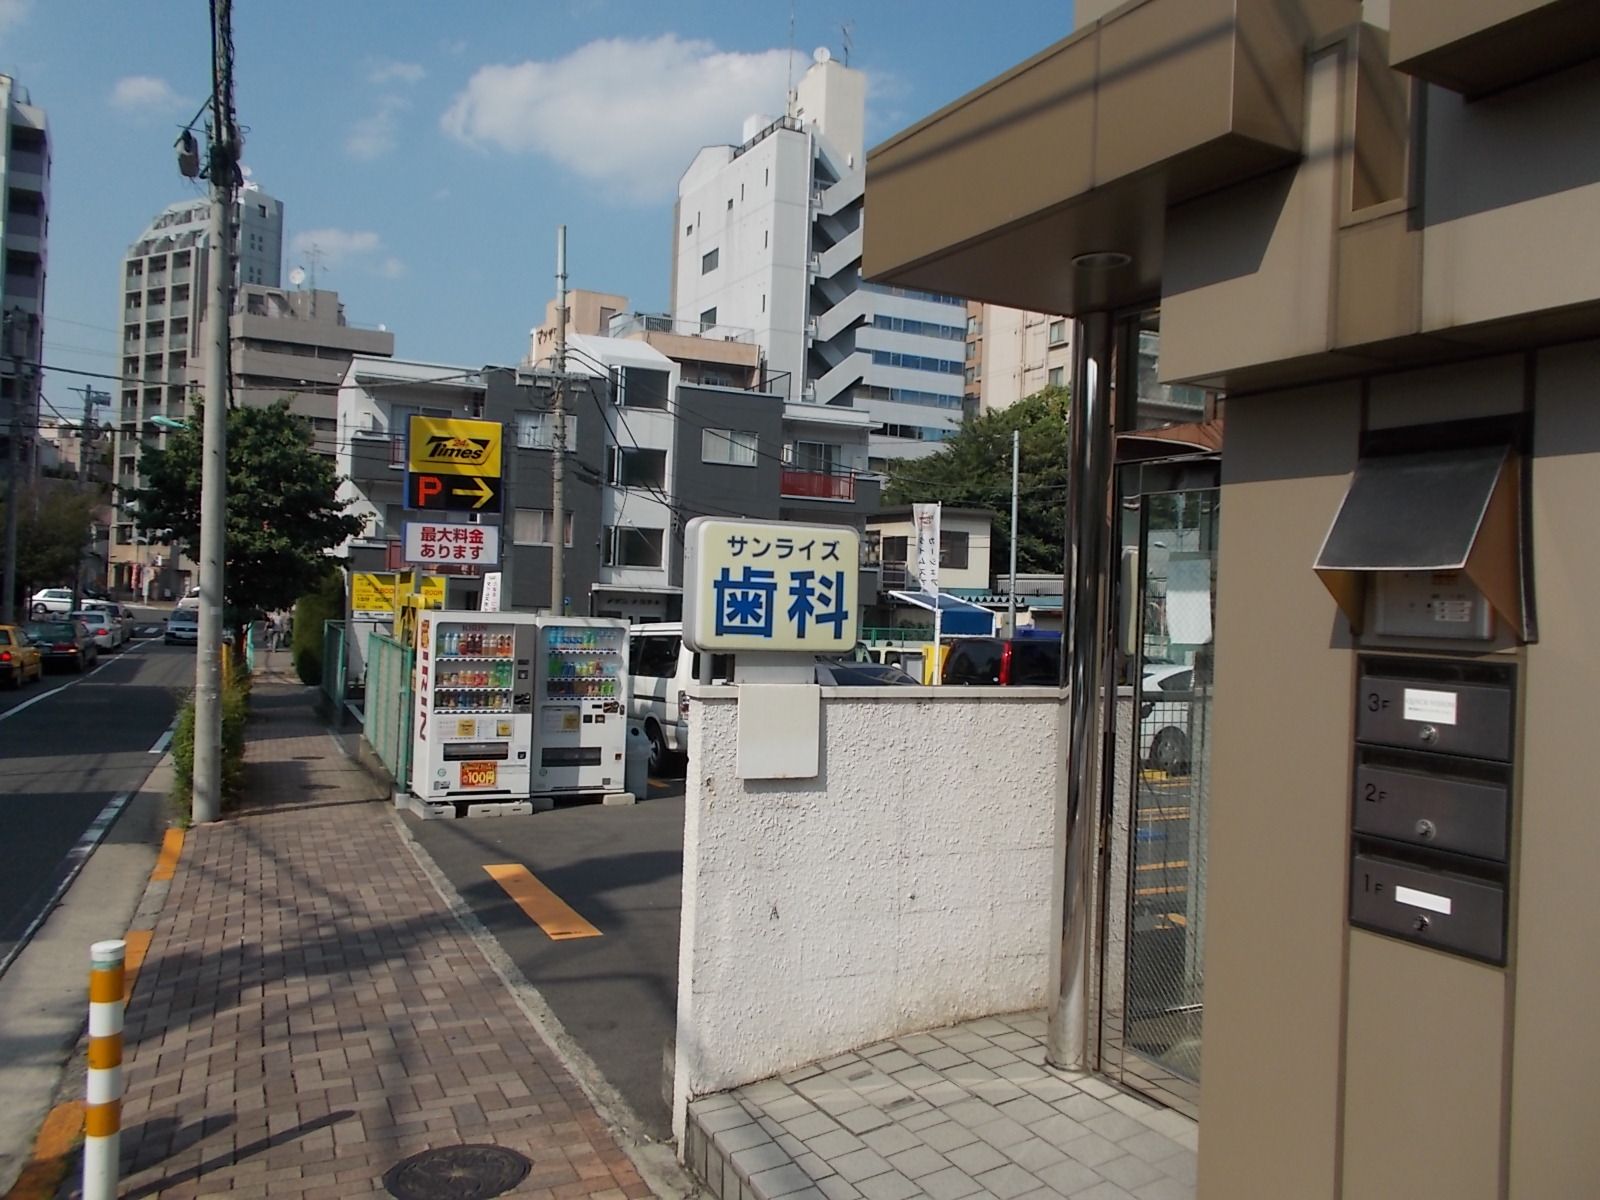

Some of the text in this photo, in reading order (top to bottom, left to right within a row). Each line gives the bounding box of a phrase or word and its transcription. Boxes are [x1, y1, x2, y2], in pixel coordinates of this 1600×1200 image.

[427, 437, 486, 459] Times
[418, 475, 442, 507] P
[420, 526, 484, 545] 最大料金
[420, 543, 484, 560] あります
[727, 535, 840, 562] サンライズ
[713, 565, 849, 640] 歯科
[1367, 692, 1391, 713] 3F
[1364, 782, 1388, 803] 2F
[1362, 873, 1384, 893] 1F
